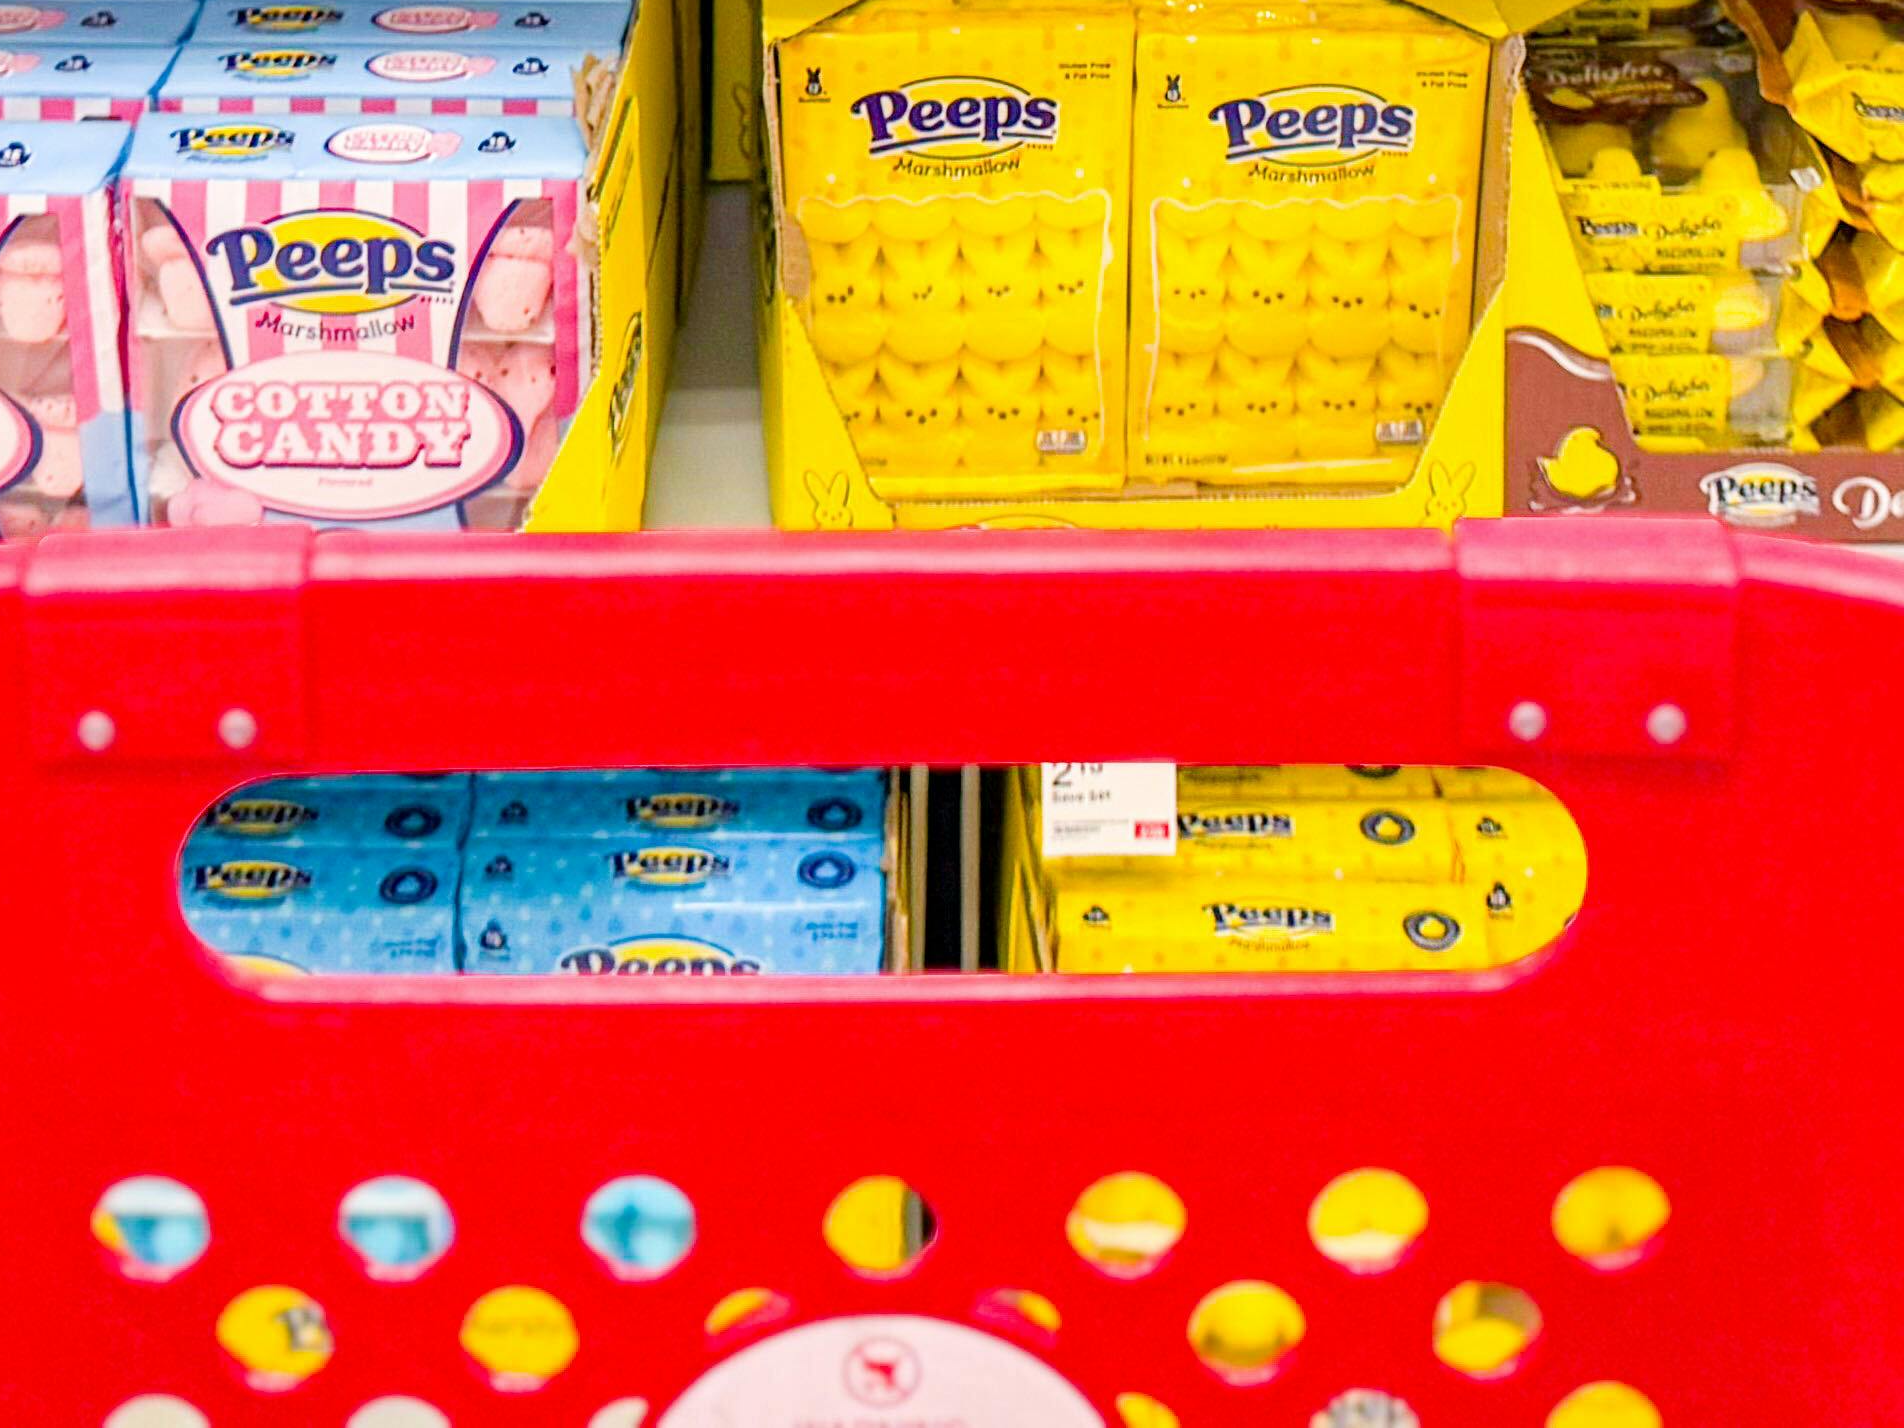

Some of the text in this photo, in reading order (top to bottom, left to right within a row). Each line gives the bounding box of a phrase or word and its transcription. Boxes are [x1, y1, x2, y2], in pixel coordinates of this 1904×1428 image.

[851, 93, 1058, 147] Peeps
[1208, 99, 1415, 156] Peeps
[170, 126, 295, 153] Peeps
[892, 155, 1024, 180] Marshmallow
[1248, 160, 1378, 185] Marshmallow
[206, 220, 457, 299] Peeps
[255, 310, 417, 347] Marshmallow
[215, 379, 469, 425] COTTON
[217, 419, 468, 469] CANDY
[1710, 473, 1818, 512] Peeps
[195, 862, 312, 894] Peeps
[611, 848, 731, 880] Peeps
[1202, 901, 1334, 937] Peeps
